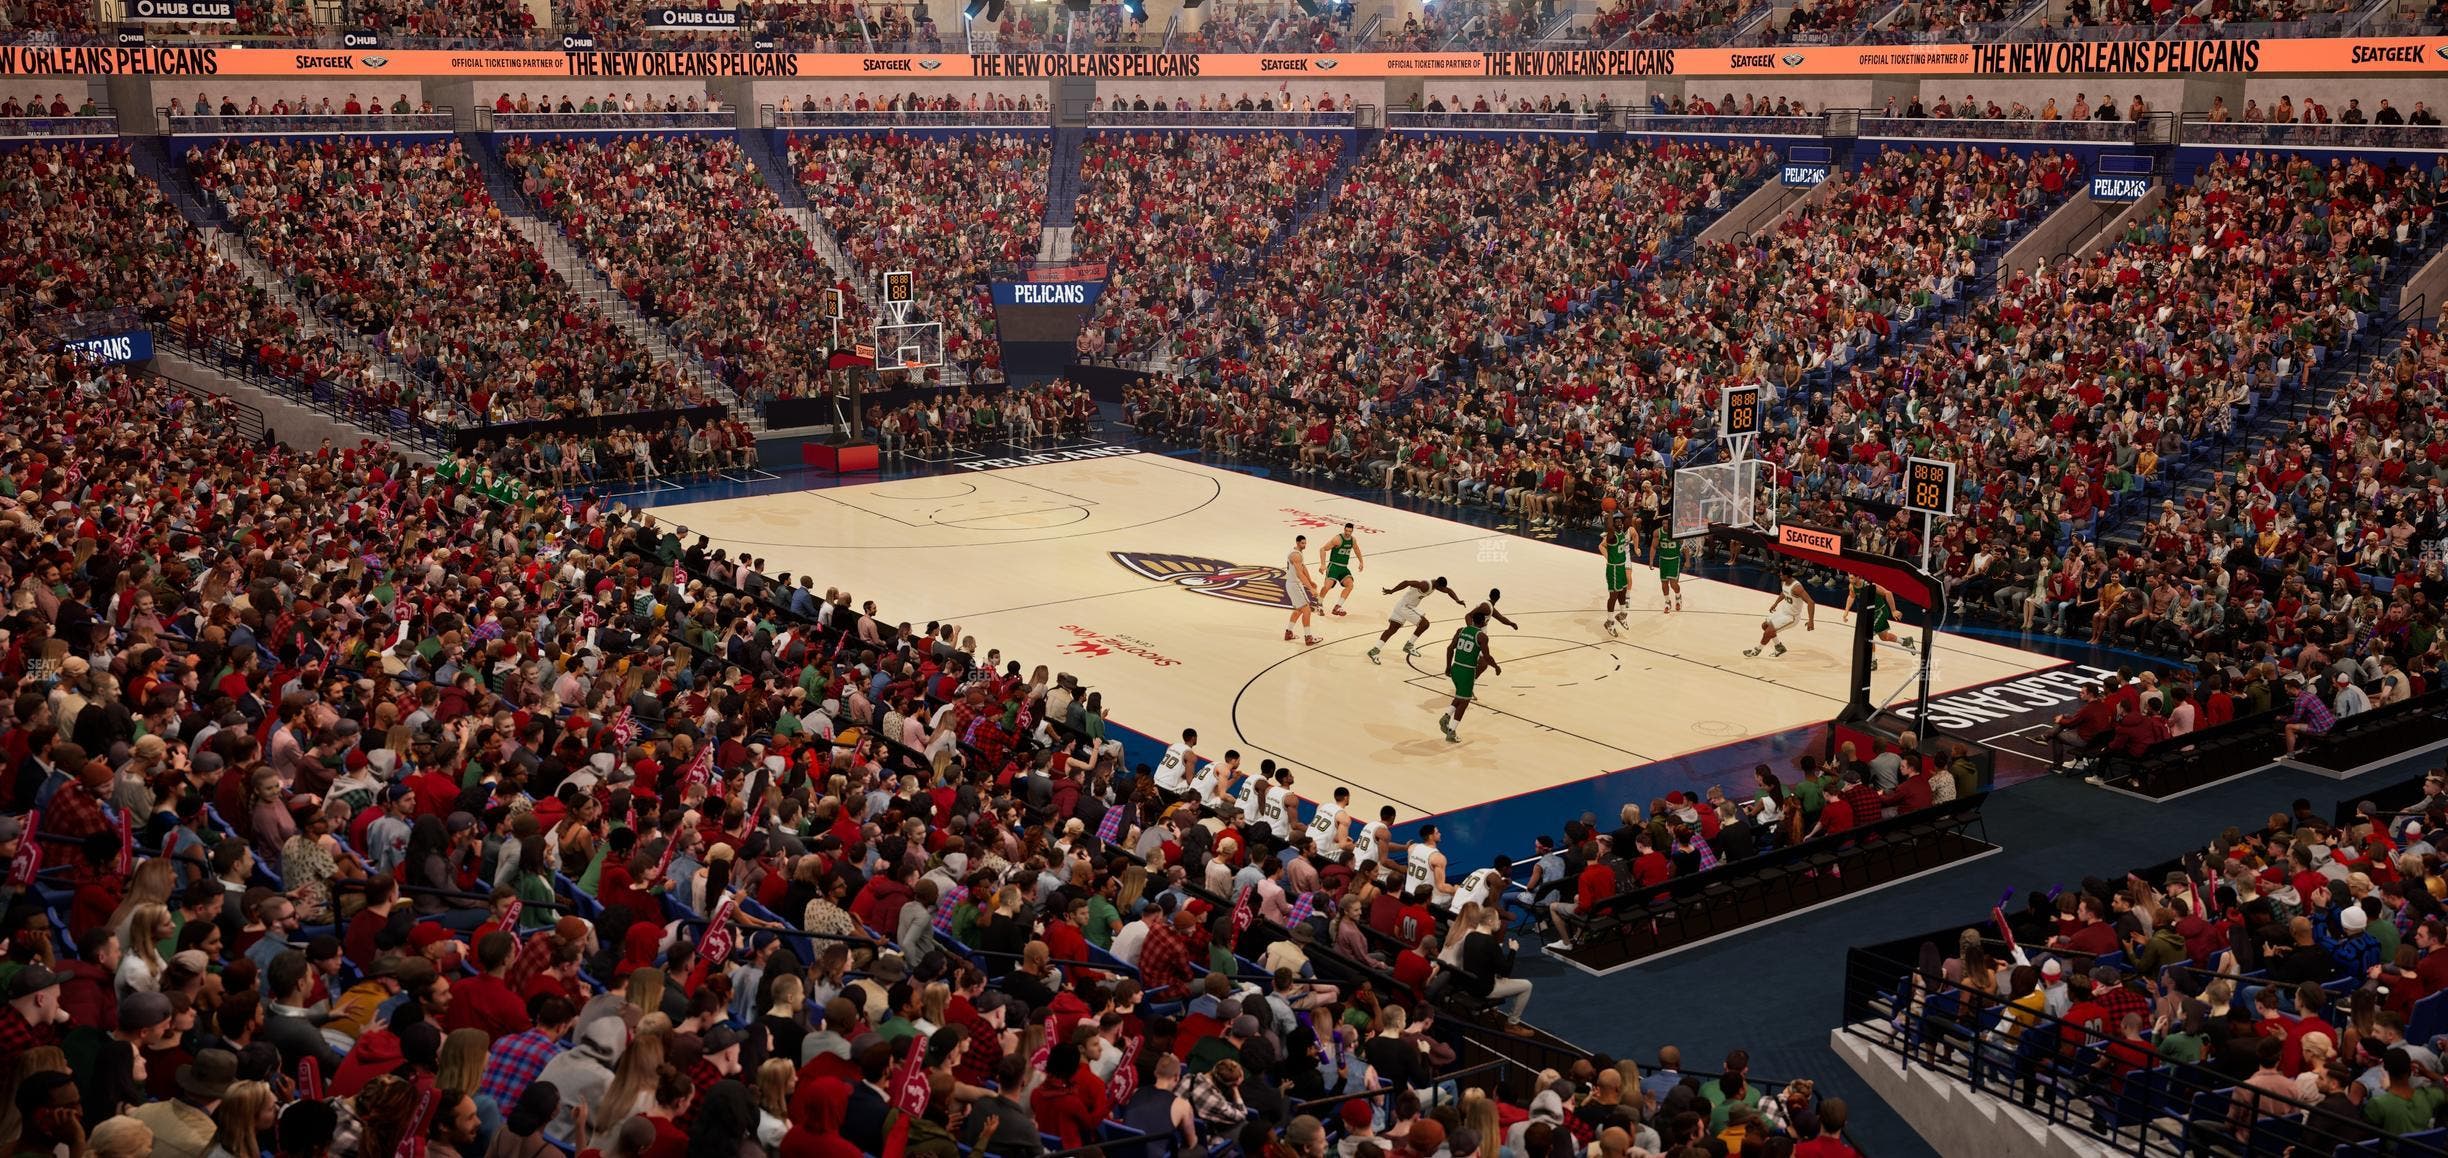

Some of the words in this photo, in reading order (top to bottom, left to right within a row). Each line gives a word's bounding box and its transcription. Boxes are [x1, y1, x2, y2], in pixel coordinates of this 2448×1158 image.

[157, 3, 187, 15] HUB
[192, 3, 230, 15] CLUB
[678, 13, 703, 23] HUB
[706, 13, 735, 24] CLUB
[357, 36, 376, 45] HUB
[574, 39, 592, 47] HUB
[21, 47, 113, 75] ORLEANS
[117, 48, 217, 75] PELICANS
[296, 56, 353, 69] SEATGEEK
[1387, 60, 1412, 69] OFFICIAL
[1414, 60, 1445, 69] TICKETING
[1446, 60, 1469, 69] PARTNER
[1472, 60, 1481, 69] OF
[1483, 52, 1511, 75] THE
[1514, 52, 1545, 75] NEW
[1547, 51, 1606, 75] ORLEANS
[1609, 50, 1675, 75] PELICANS
[1730, 54, 1776, 68] SEATGEEK
[1859, 55, 1889, 65] OFFICIAL
[1890, 54, 1926, 65] TICKETING
[1927, 54, 1957, 64] PARTNER
[1959, 54, 1969, 64] OF
[1972, 44, 2005, 73] THE
[2009, 43, 2053, 73] NEW
[2056, 41, 2150, 73] ORLEANS
[2153, 39, 2260, 72] PELICANS
[2352, 44, 2425, 64] SEATGEEK
[451, 59, 483, 68] OFFICIAL
[485, 59, 521, 68] TICKETING
[522, 59, 553, 68] PARTNER
[554, 59, 563, 68] OF
[565, 52, 598, 75] THE
[601, 52, 638, 75] NEW
[642, 52, 717, 75] ORLEANS
[721, 53, 798, 76] PELICANS
[863, 59, 911, 72] SEATGEEK
[971, 55, 1000, 76] THE
[1004, 55, 1041, 76] NEW
[1044, 55, 1120, 76] ORLEANS
[1123, 54, 1200, 76] PELICANS
[1261, 59, 1308, 71] SEATGEEK
[1785, 167, 1825, 183] PELICANS
[2094, 179, 2146, 197] PELICANS
[1014, 284, 1084, 303] PELICANS
[1732, 394, 1742, 406] 88
[1744, 392, 1755, 405] 88
[1733, 408, 1752, 429] 88
[954, 445, 1141, 471] PELICANS
[1915, 465, 1928, 480] 88
[1931, 467, 1944, 483] 88
[1916, 483, 1939, 507] 88
[1786, 530, 1834, 551] SEATGEEK
[1457, 637, 1475, 653] 00
[1402, 916, 1418, 940] 00
